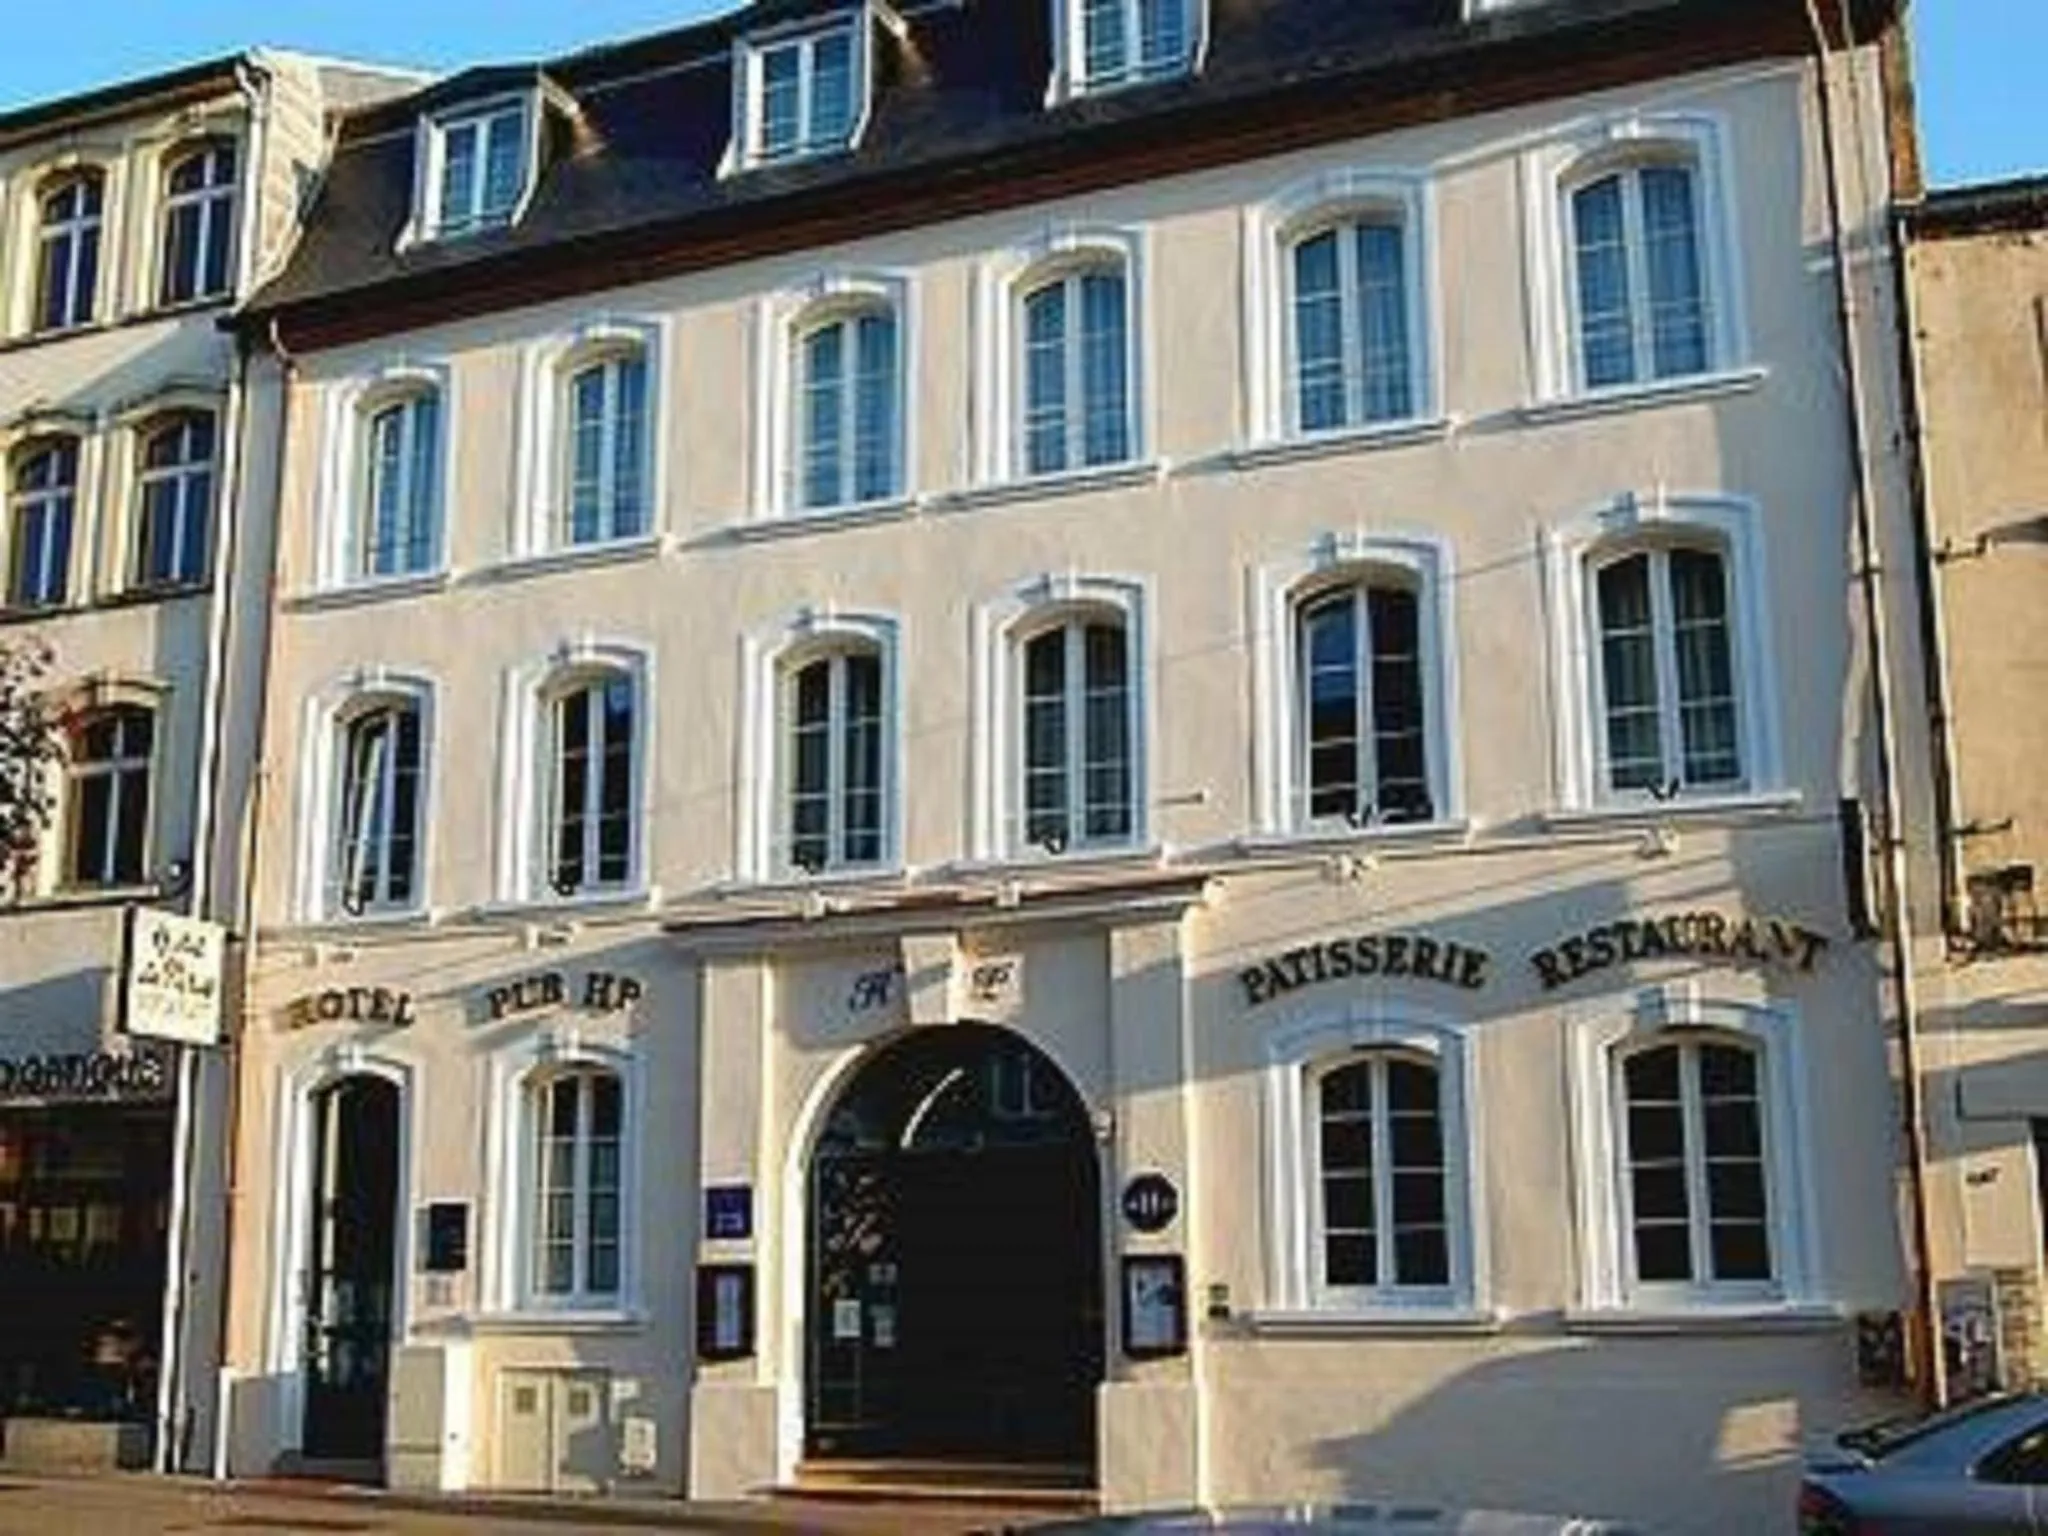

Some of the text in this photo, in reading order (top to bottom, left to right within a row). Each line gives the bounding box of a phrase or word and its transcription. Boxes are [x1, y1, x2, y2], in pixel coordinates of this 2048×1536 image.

[1239, 934, 1489, 1004] PATISSERIE
[1530, 912, 1828, 987] RESTAURANT
[284, 987, 416, 1030] HOTEL
[485, 971, 642, 1019] PUB HP
